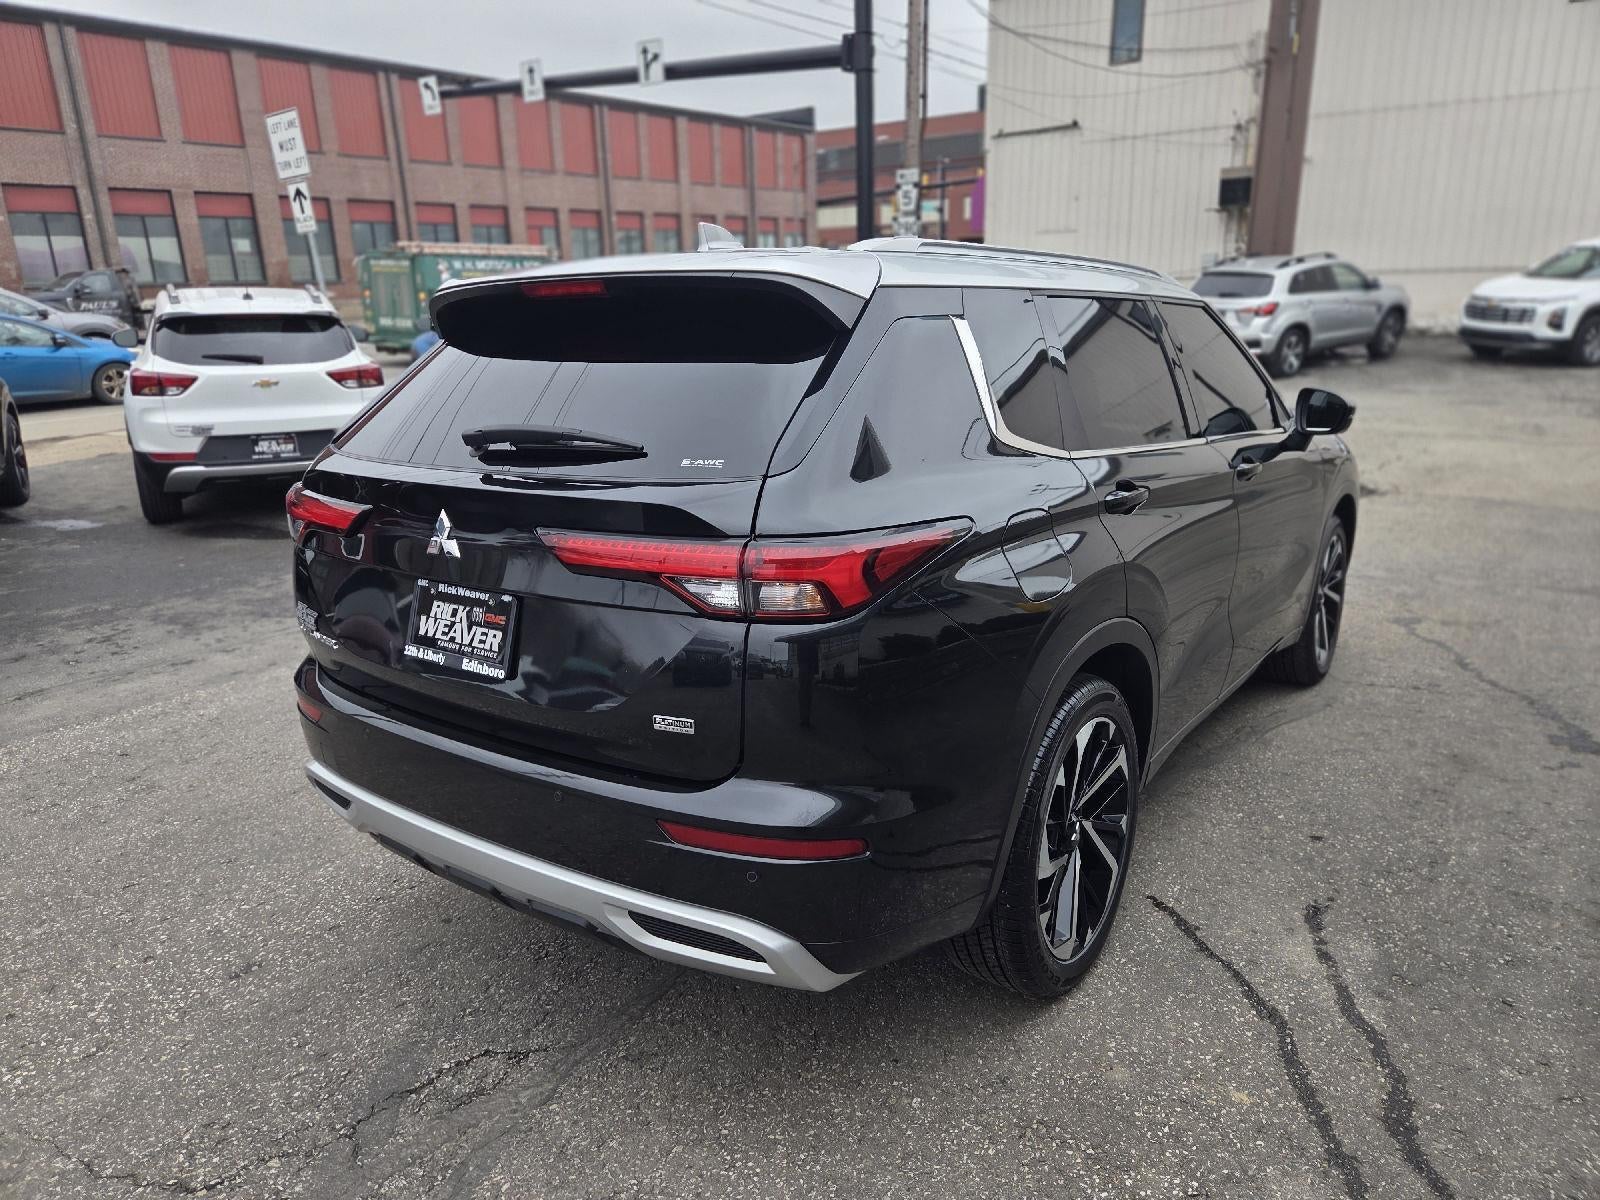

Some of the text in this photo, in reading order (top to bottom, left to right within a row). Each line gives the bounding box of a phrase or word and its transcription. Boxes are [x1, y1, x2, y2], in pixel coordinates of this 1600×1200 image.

[270, 117, 298, 134] LEFT LANE
[278, 137, 297, 152] MUST
[278, 156, 306, 172] TURN LEFT
[902, 190, 912, 207] 5
[430, 600, 471, 624] RICK
[418, 614, 503, 652] WEAVER
[418, 648, 424, 659] &
[424, 649, 446, 666] Liberty
[437, 640, 498, 659] FAMOUS FOR SERVICE
[461, 657, 506, 679] Edinboro
[655, 717, 691, 729] PLATINUM
